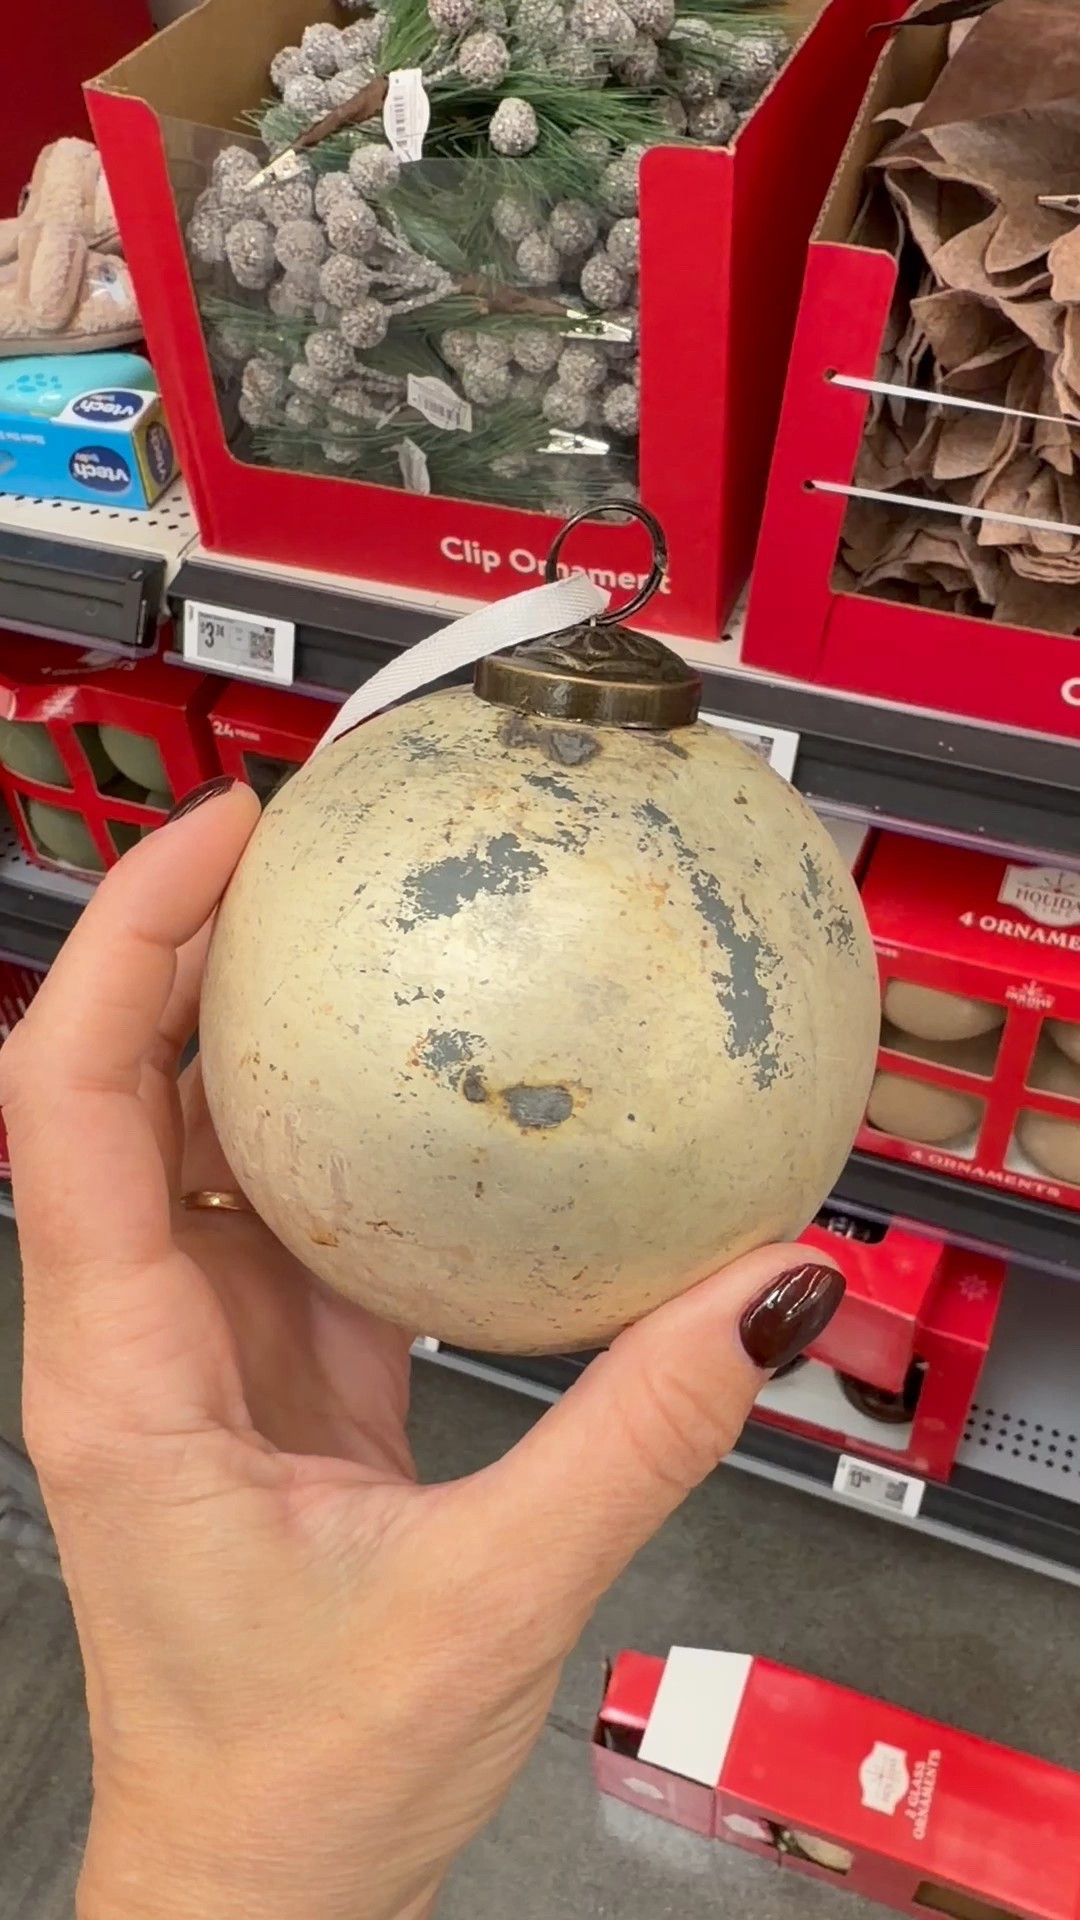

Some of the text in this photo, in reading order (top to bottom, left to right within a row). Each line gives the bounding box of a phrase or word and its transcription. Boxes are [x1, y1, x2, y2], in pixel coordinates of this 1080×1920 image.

[440, 536, 501, 573] Clip
[958, 910, 976, 927] 4
[911, 1150, 1061, 1198] 4 ORNAMENTS
[912, 1749, 942, 1840] ORNAMENTS
